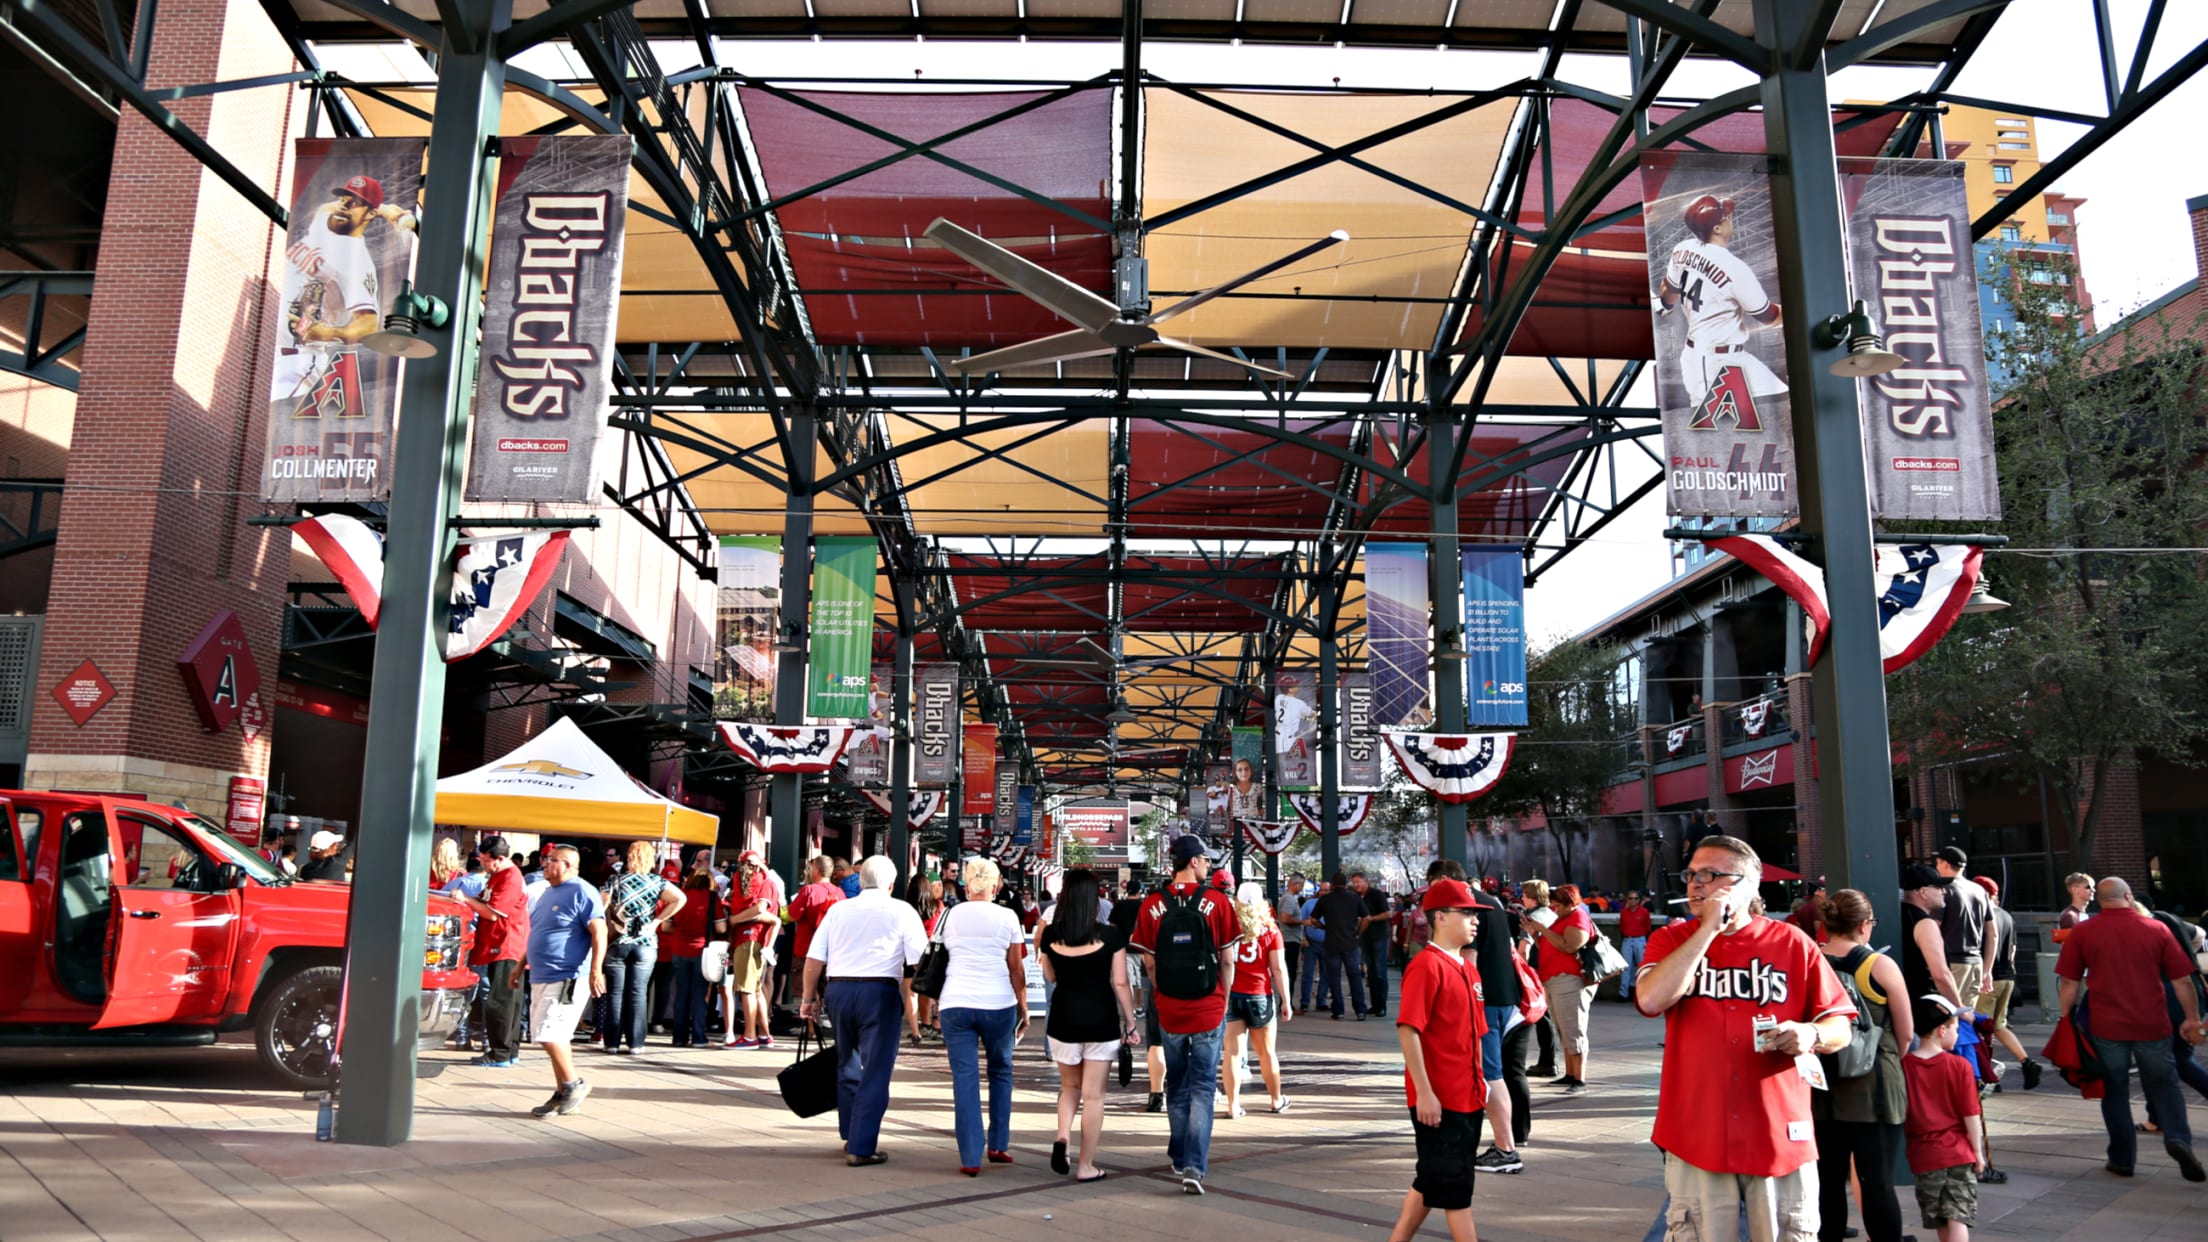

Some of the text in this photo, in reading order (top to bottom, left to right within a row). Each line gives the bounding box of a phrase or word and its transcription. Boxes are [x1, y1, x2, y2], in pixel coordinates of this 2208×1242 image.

[273, 444, 319, 458] JOSH
[500, 440, 566, 451] dbacks.com
[1671, 456, 1720, 469] PAUL
[1895, 460, 1958, 470] dbacks.com
[272, 458, 378, 483] COLLMENTER
[1672, 470, 1787, 497] GOLDSCHMIDT
[220, 635, 244, 650] GATE
[213, 653, 239, 709] A
[842, 676, 866, 688] aps
[1500, 683, 1524, 695] aps
[486, 778, 577, 791] CHEVROLET
